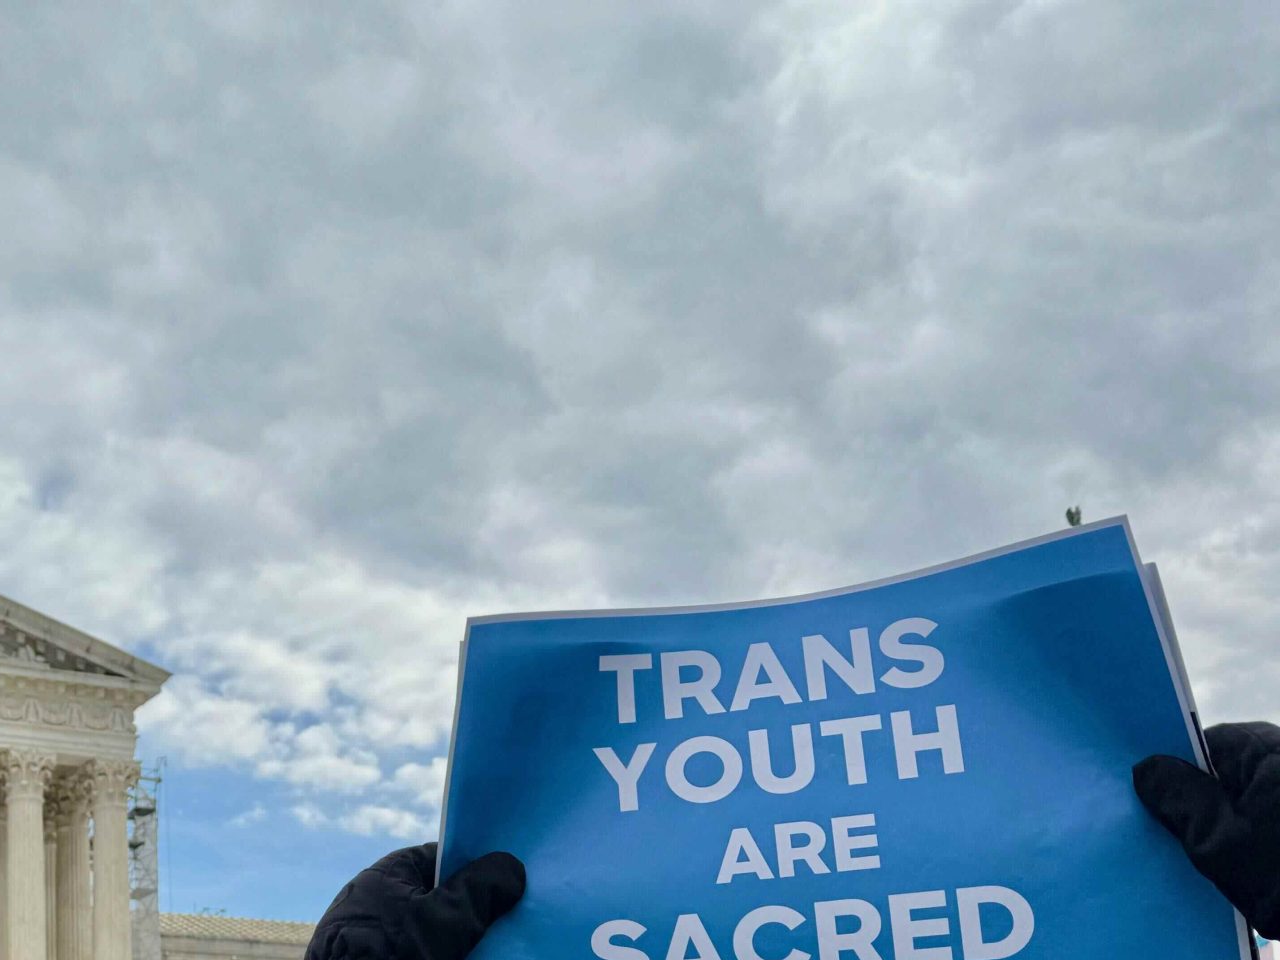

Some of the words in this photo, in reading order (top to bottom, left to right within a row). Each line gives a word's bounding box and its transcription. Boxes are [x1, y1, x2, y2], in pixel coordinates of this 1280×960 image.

[598, 617, 945, 724] TRANS
[592, 704, 964, 812] YOUTH
[716, 813, 881, 884] ARE
